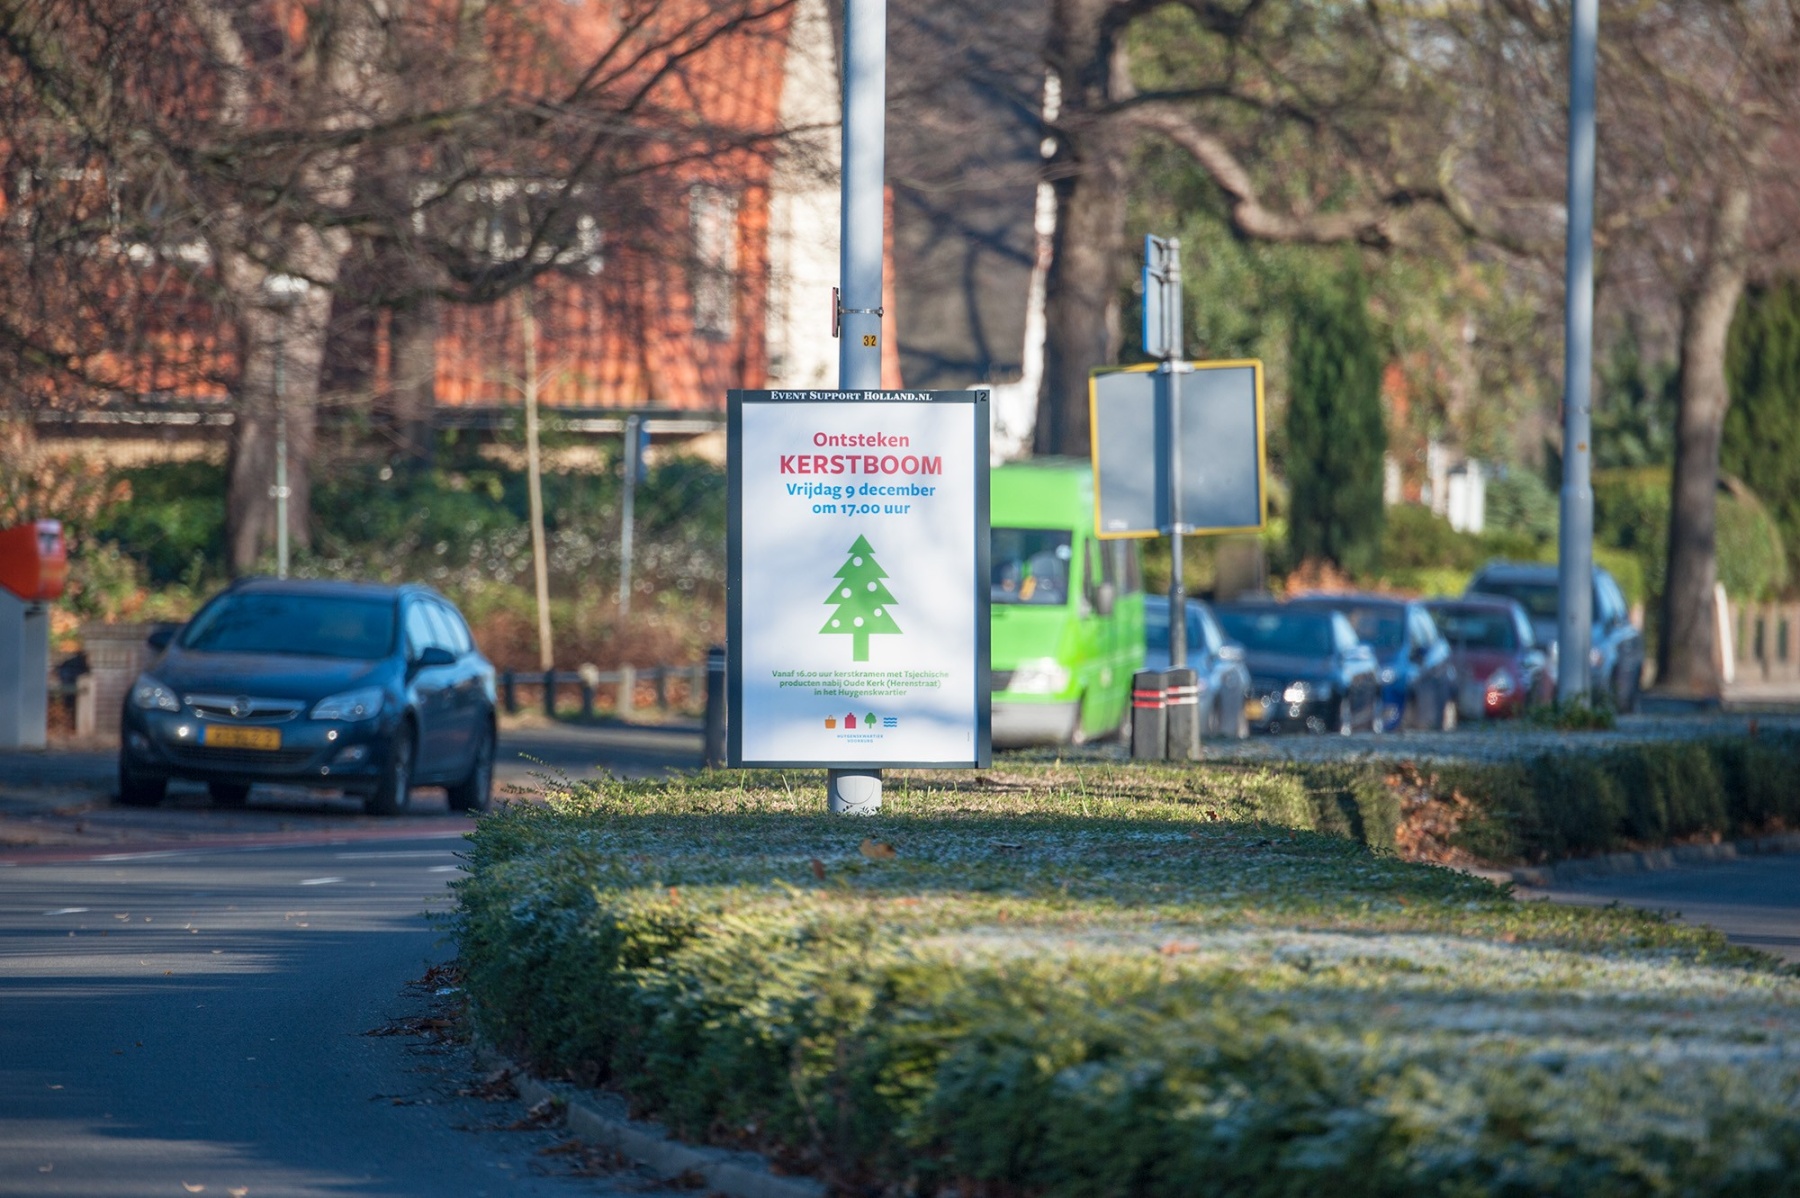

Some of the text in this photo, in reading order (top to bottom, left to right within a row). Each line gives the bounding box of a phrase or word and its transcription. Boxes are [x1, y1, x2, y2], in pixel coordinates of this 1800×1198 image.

[863, 335, 876, 347] 32
[979, 392, 987, 402] 2
[813, 431, 909, 447] Ontsteken
[780, 455, 943, 475] KERSTBOOM
[786, 482, 936, 500] Vrijdag 9 december
[812, 503, 910, 517] om 17.00 uur
[772, 670, 795, 678] Vanaf
[796, 670, 817, 678] 16.00
[834, 670, 885, 678] kerstkramen
[887, 670, 902, 678] met
[904, 670, 949, 680] Tsjechische
[779, 679, 941, 688] producten nabij Oude Kerk (Herenstraat)
[814, 688, 907, 698] in het Huygenskwartier
